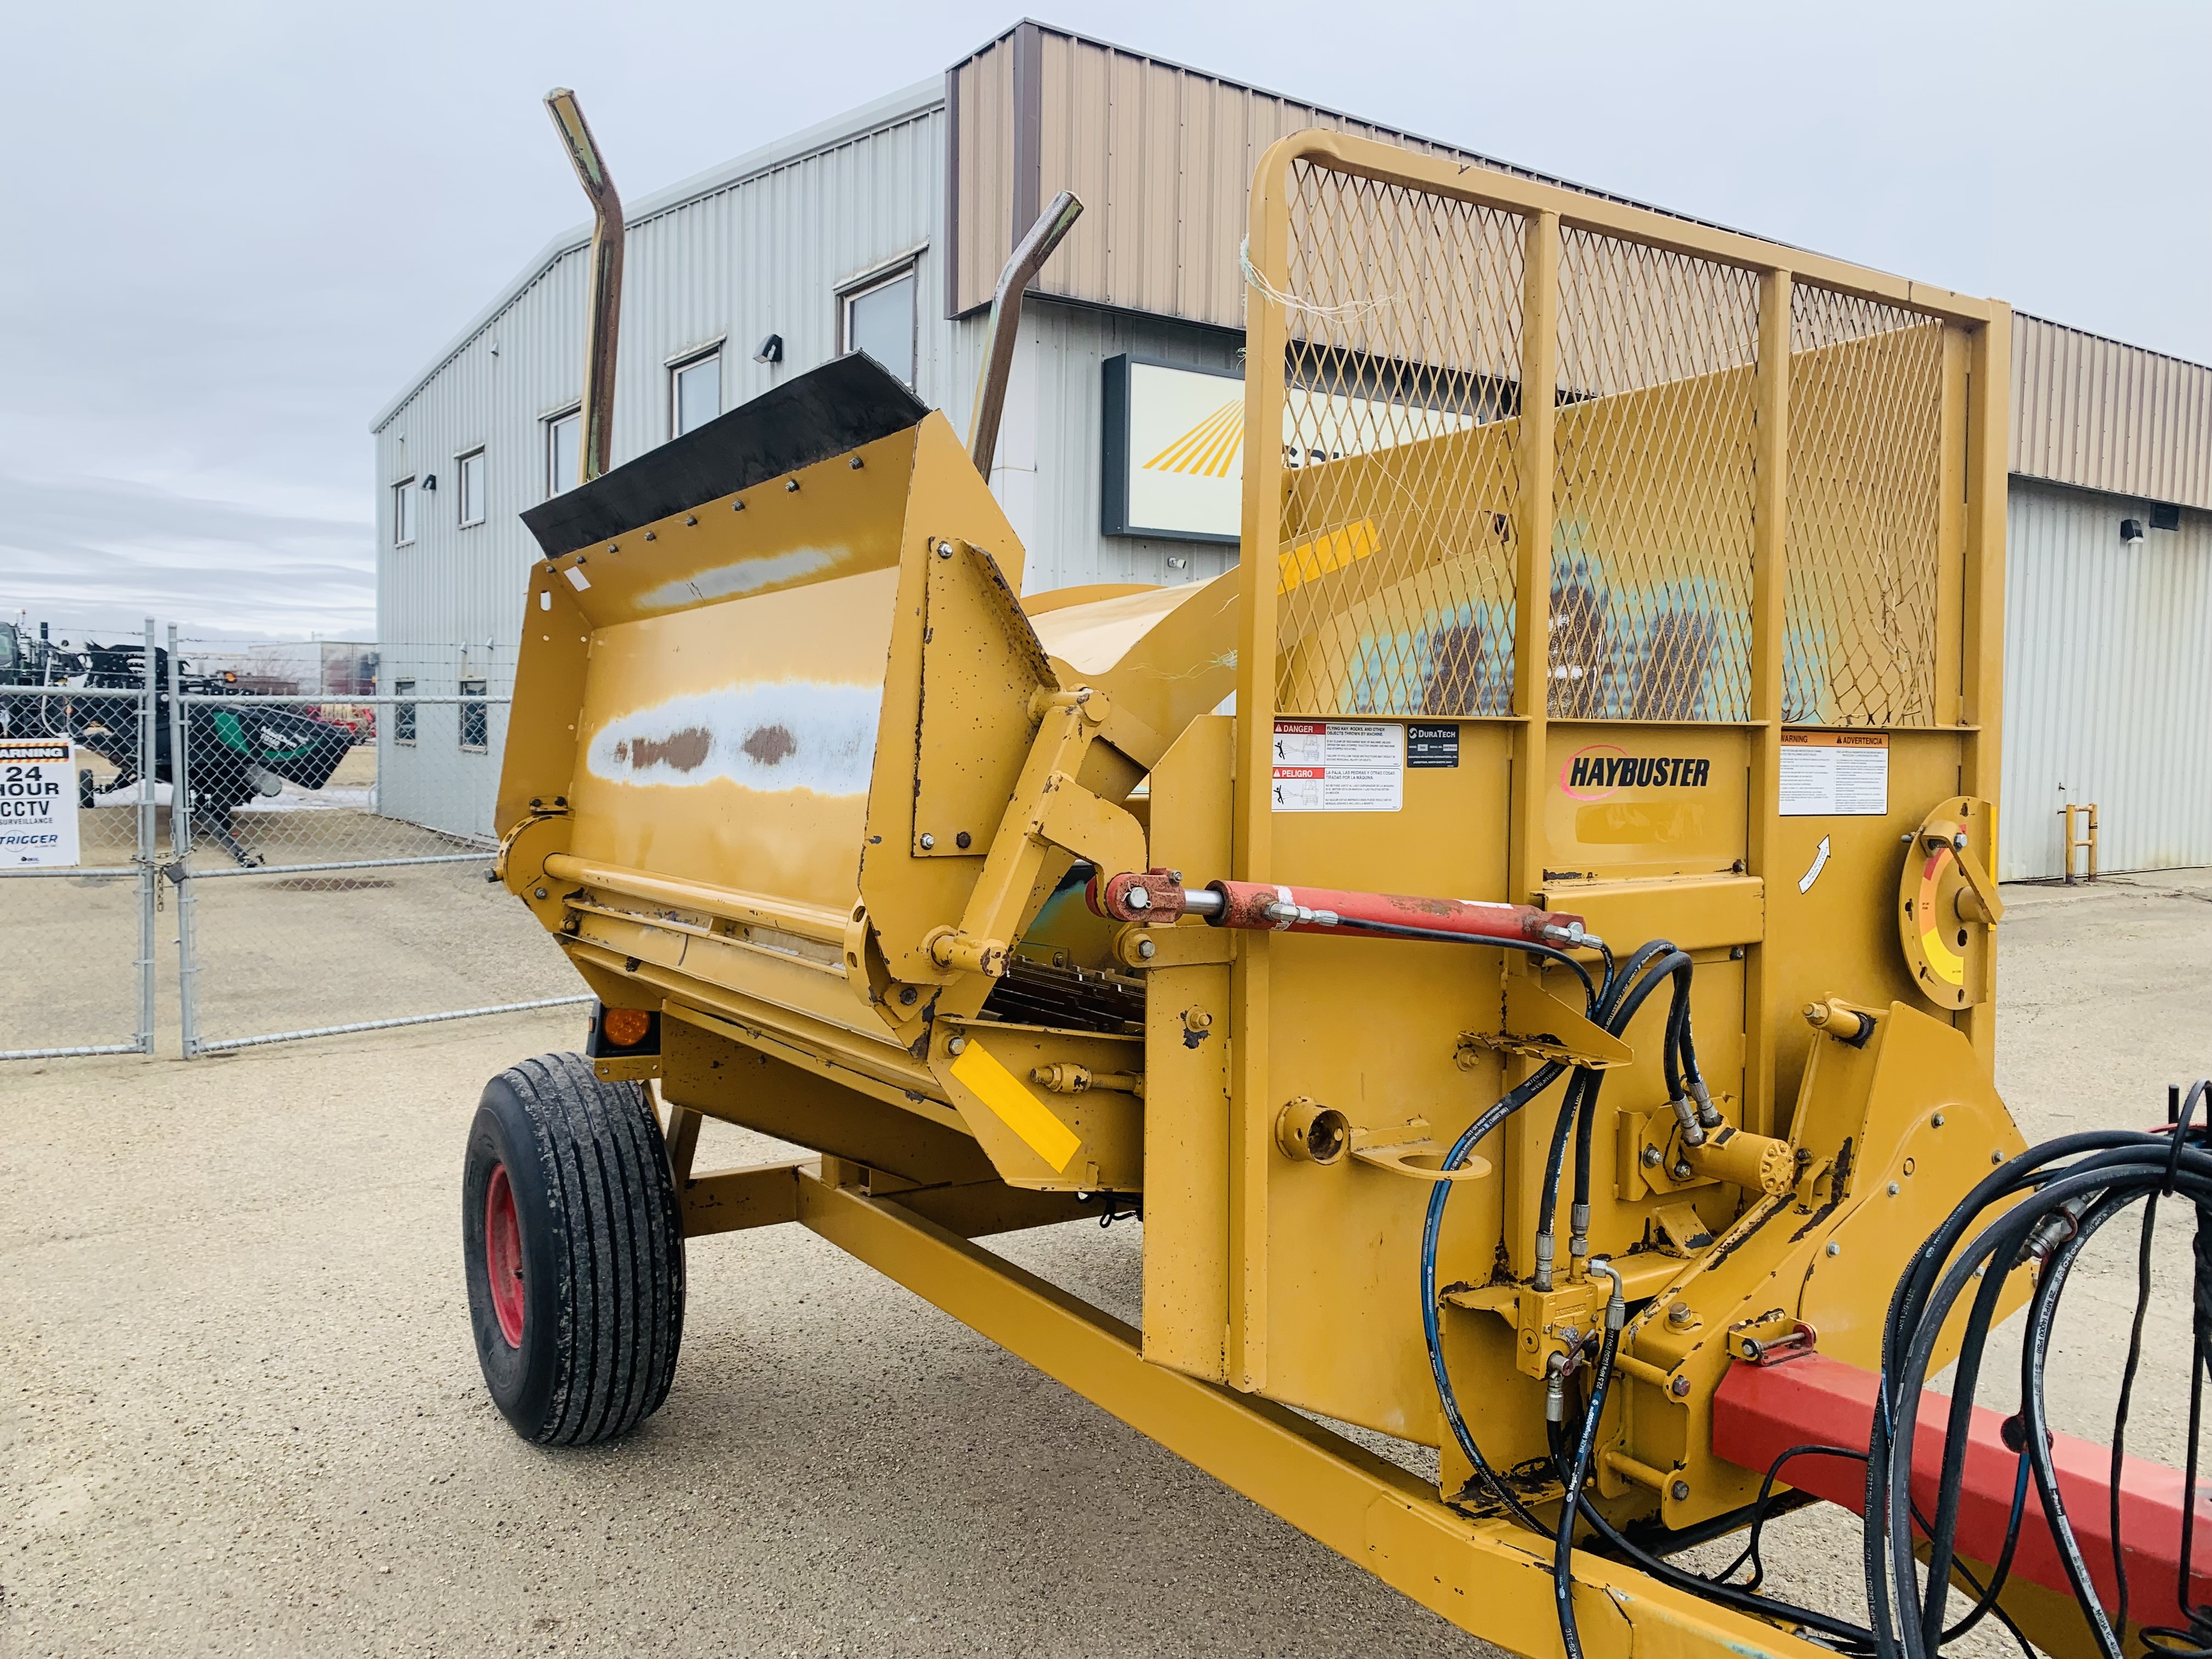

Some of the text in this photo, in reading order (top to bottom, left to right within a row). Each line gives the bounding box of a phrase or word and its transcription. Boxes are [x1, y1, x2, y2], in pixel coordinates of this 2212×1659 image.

[1284, 725, 1313, 733] DANGER
[1843, 737, 1882, 745] ADVERTENCIA
[0, 748, 63, 758] ARNING
[5, 766, 42, 782] 24
[1570, 758, 1710, 787] HAYBUSTER
[1, 800, 49, 816] CCTV
[0, 835, 58, 845] TRIGGER
[1476, 1117, 1486, 1126] MSHA
[1474, 1127, 1485, 1137] Flame
[1463, 1135, 1477, 1151] Resistant
[1457, 1150, 1465, 1161] MSHA
[2049, 1290, 2056, 1300] 28
[2043, 1300, 2053, 1317] MPa
[2039, 1317, 2047, 1338] (4000
[1579, 1437, 1587, 1454] 8M2K
[2052, 1493, 2062, 1515] Parker
[2095, 1609, 2107, 1631] MSHA
